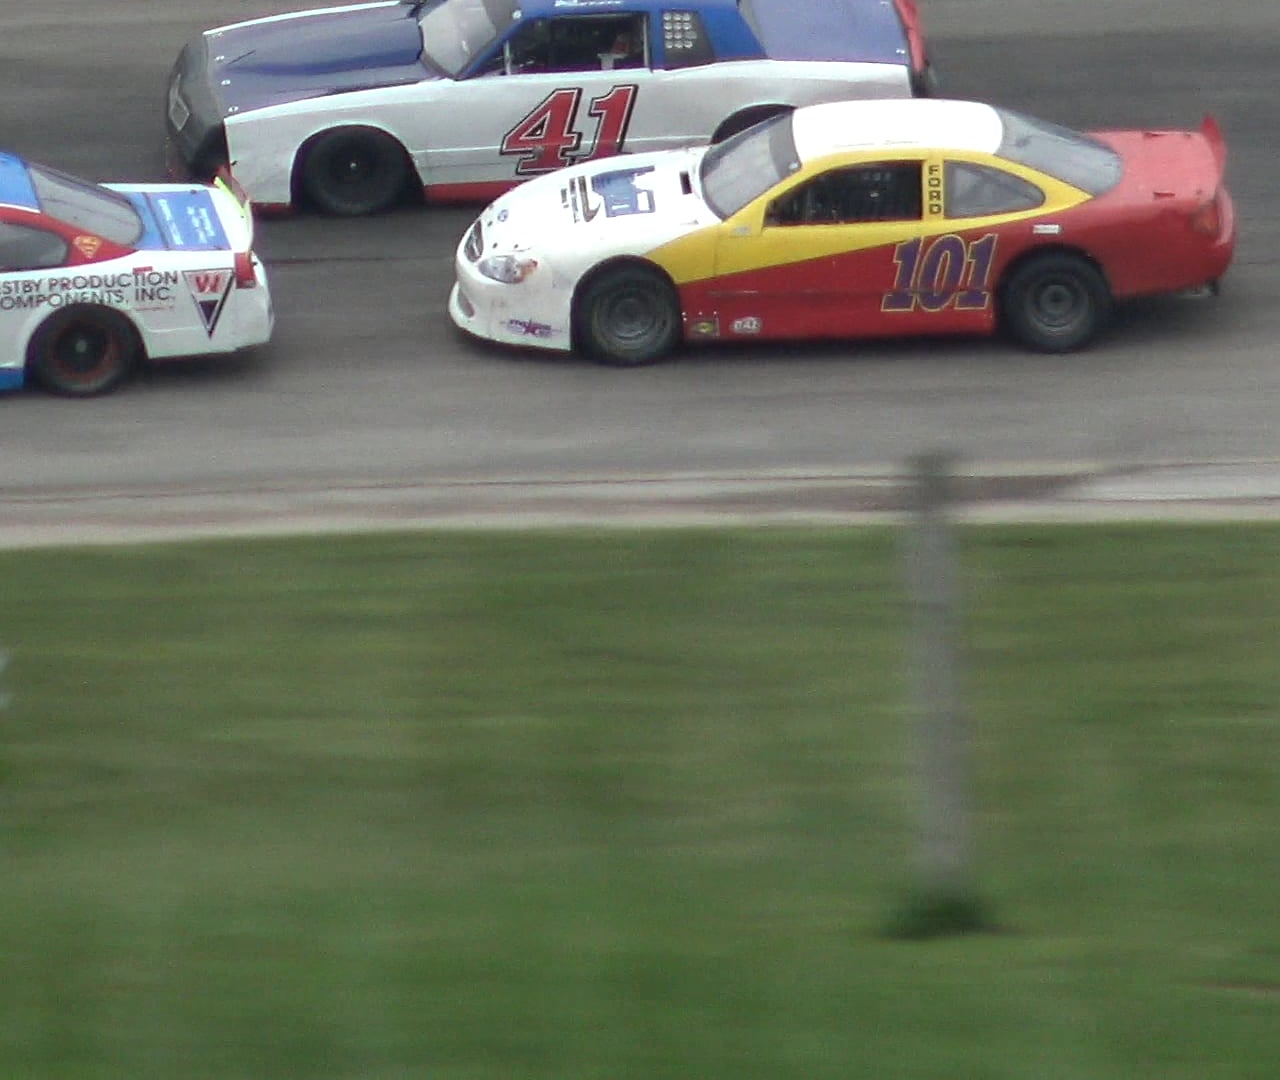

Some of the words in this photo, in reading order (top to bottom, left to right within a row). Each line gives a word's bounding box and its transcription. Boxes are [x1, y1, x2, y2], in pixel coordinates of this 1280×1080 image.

[500, 84, 639, 175] 41
[927, 164, 944, 216] FORD
[48, 269, 179, 291] PRODUCTION
[195, 275, 219, 293] W
[881, 233, 998, 312] 101
[135, 286, 176, 302] INC.
